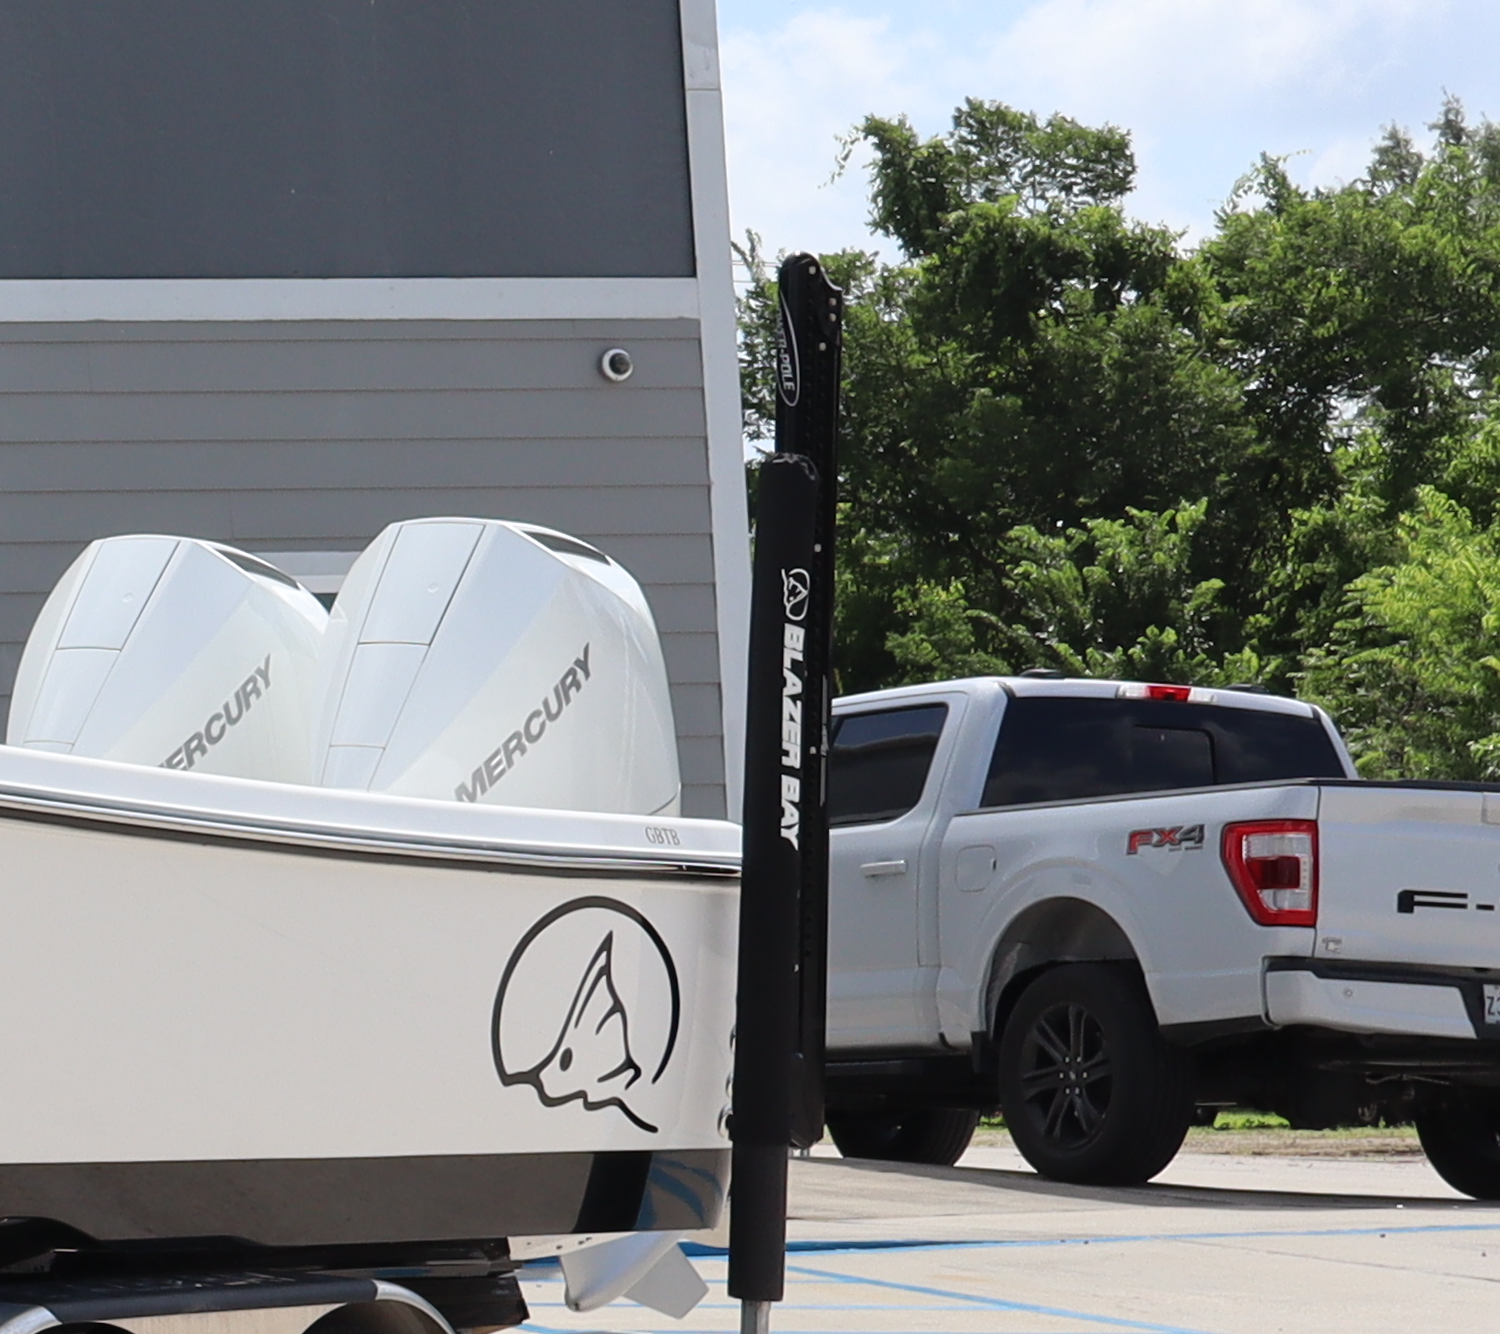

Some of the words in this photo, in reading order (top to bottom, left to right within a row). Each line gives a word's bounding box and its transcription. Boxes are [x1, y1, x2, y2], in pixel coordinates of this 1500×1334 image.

[158, 653, 271, 771] ERCURY
[453, 642, 591, 803] MERCURY
[780, 622, 806, 769] BLAZER
[780, 774, 800, 851] BAY
[1126, 824, 1205, 855] FX4
